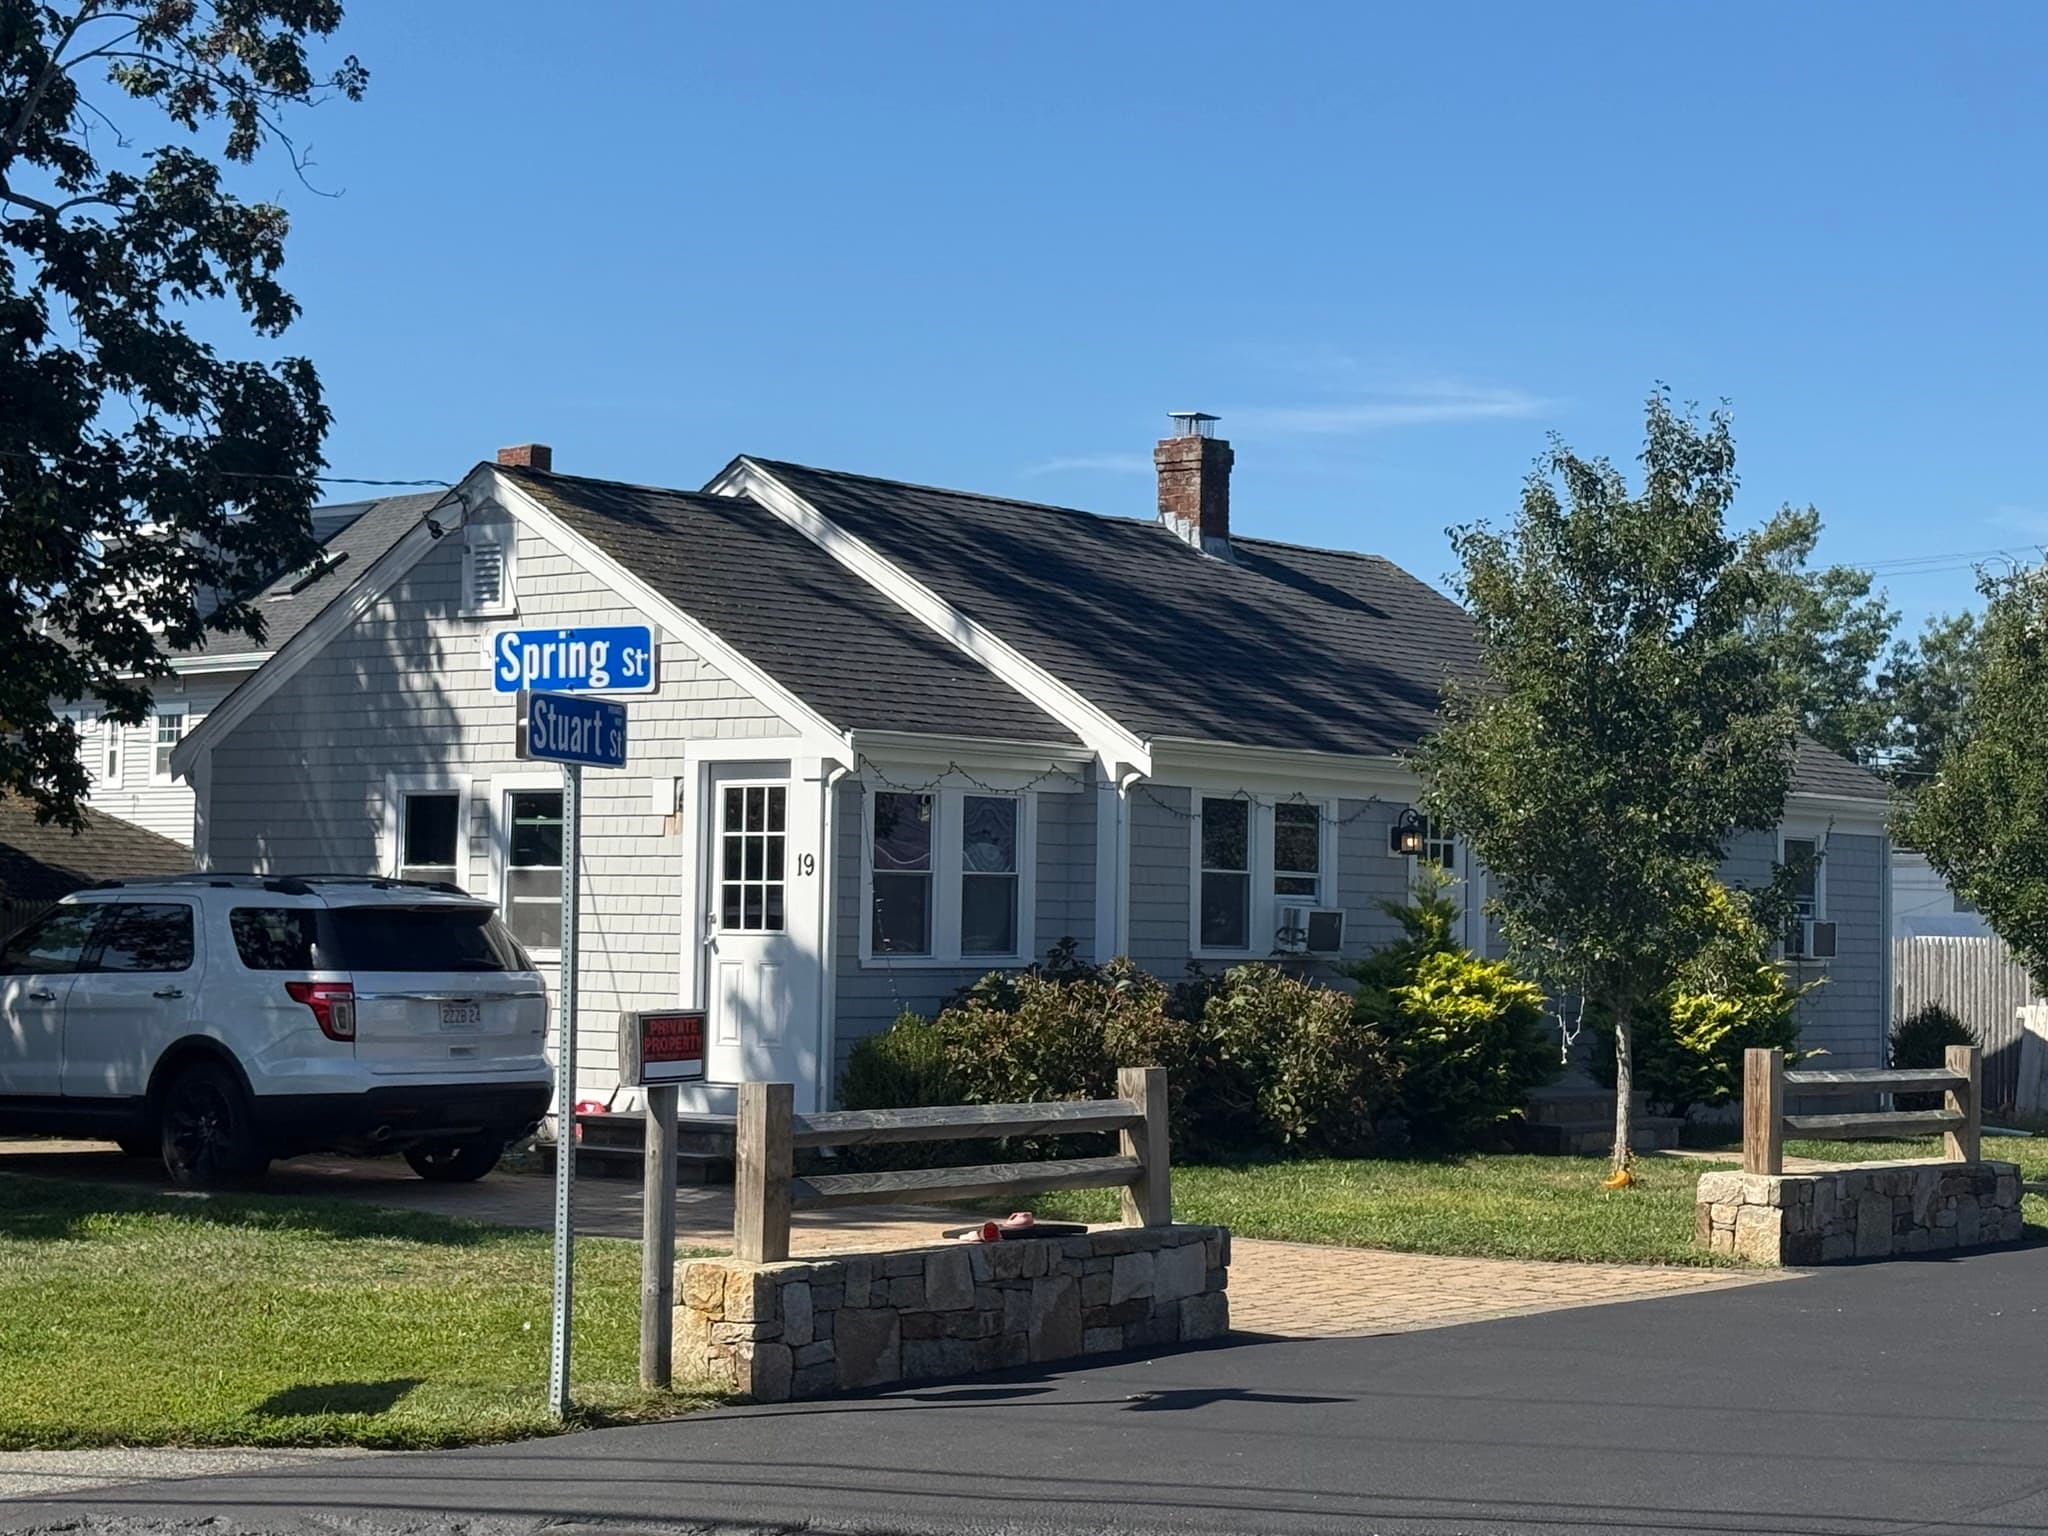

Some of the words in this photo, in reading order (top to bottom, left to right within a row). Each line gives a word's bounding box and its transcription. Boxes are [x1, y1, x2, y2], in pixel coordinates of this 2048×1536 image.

[500, 630, 610, 691] Spring
[622, 647, 645, 677] St
[533, 699, 603, 756] Stuart
[609, 728, 622, 758] St
[797, 853, 815, 877] 19
[650, 1019, 697, 1034] PRIVATE
[644, 1035, 702, 1051] PROPERTY
